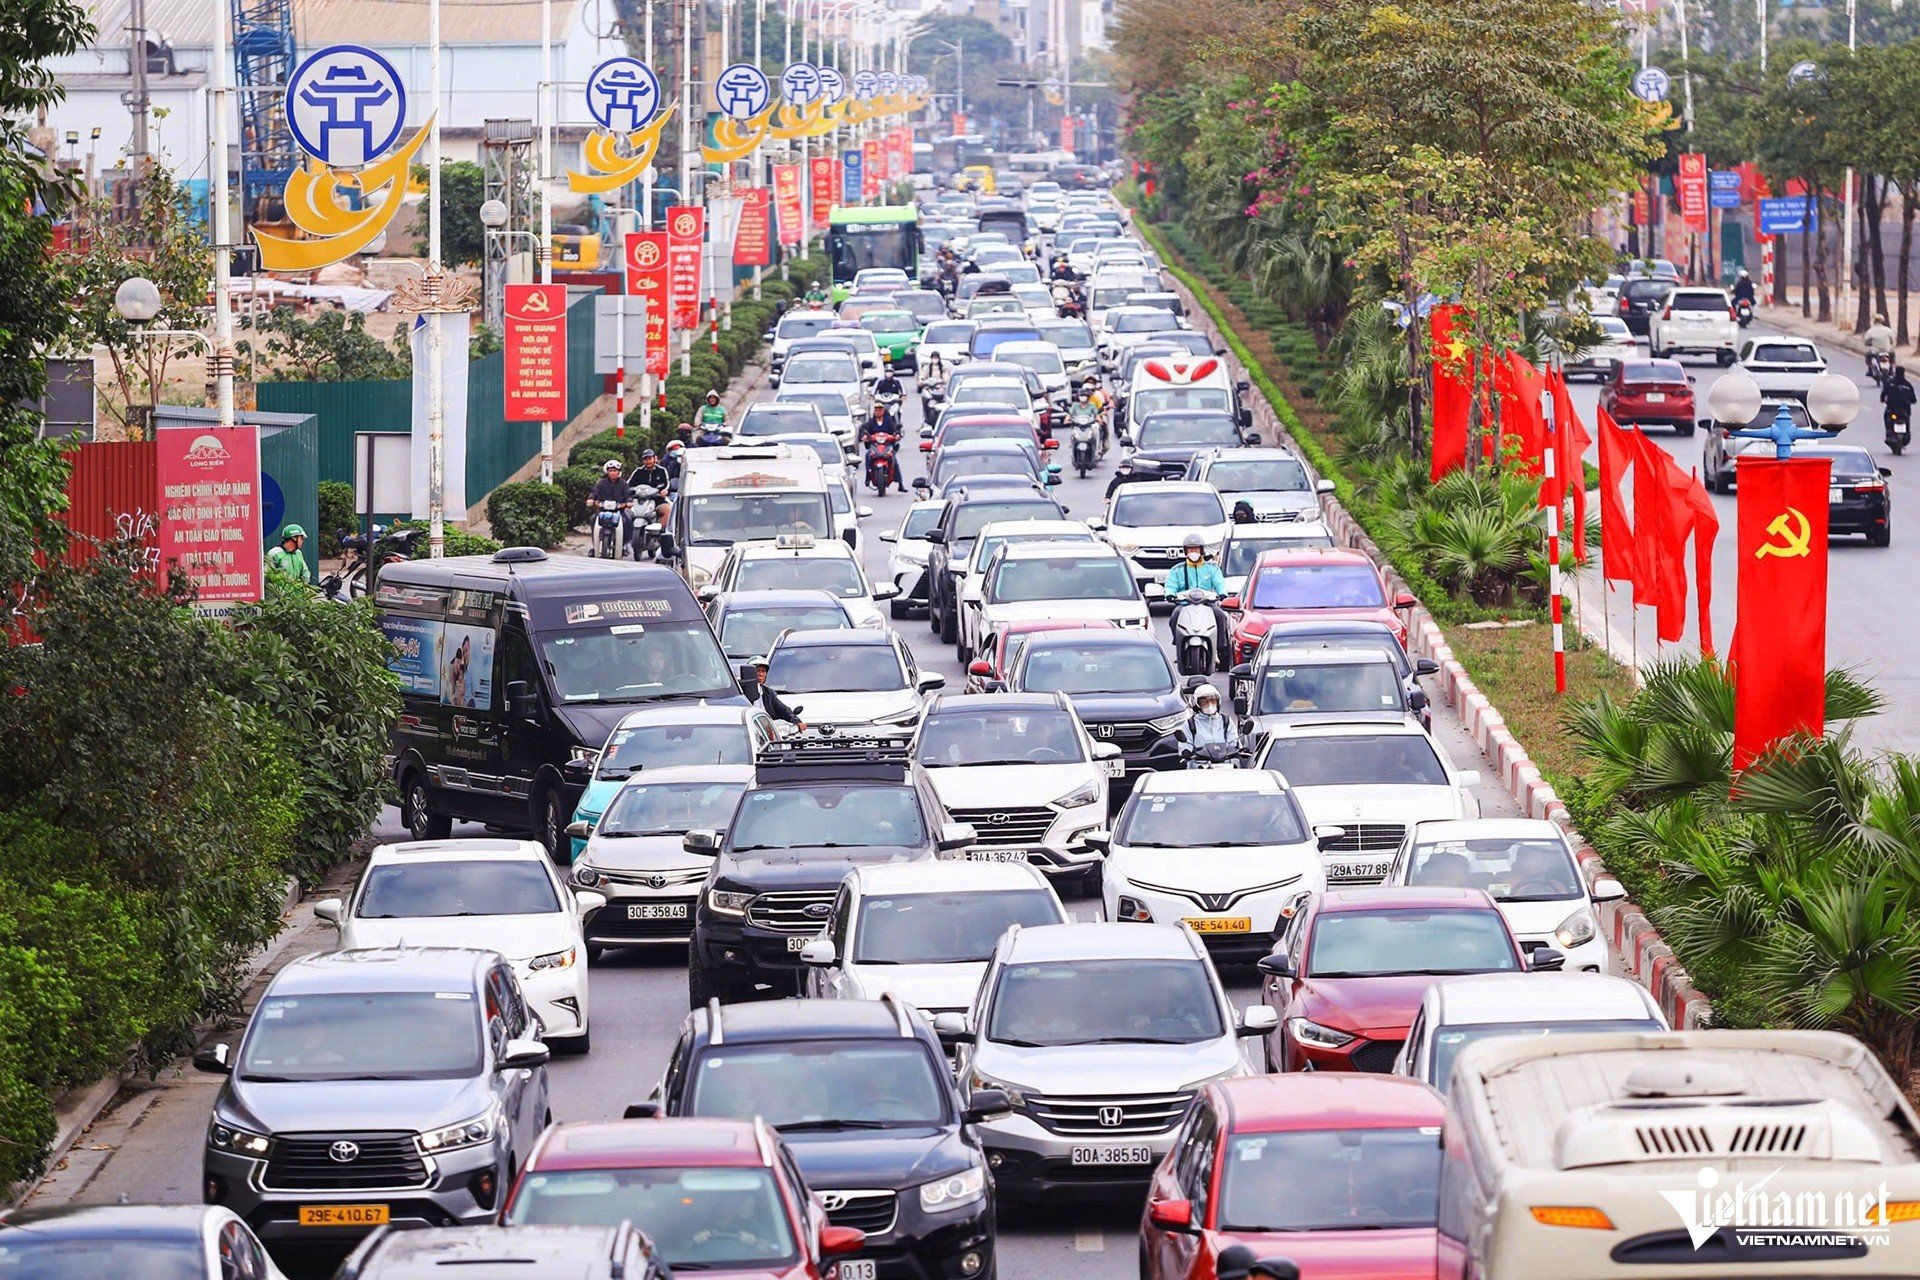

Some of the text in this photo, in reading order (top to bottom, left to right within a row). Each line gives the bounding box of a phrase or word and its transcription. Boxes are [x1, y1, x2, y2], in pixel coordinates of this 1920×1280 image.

[519, 346, 552, 355] THUỘC VỀ
[521, 357, 550, 366] DÂN TỘC
[519, 368, 534, 376] VIỆT
[520, 378, 552, 386] VĂN HIẾN
[511, 390, 521, 398] VÀ
[539, 390, 560, 398] HÙNG!
[165, 479, 251, 498] NGHIÊM CHỈNH CHẤP HÀNH
[167, 505, 181, 520] CÁC
[196, 506, 213, 522] ĐỊNH
[214, 504, 222, 518] VỀ
[223, 503, 240, 521] TRẬT
[241, 504, 250, 520] TỰ
[174, 526, 244, 543] AN TOÀN GIAO THÔNG,
[185, 547, 234, 566] TRẬT TỰ ĐÔ THỊ
[190, 575, 206, 588] SINH
[223, 571, 251, 586] TRƯỜNG!
[602, 600, 644, 612] HOÀNG
[1333, 864, 1388, 876] 29A-677.88
[629, 904, 686, 918] 30E-358.49
[1074, 1148, 1148, 1162] 30A-385.50
[307, 1209, 381, 1222] 29E-410.67
